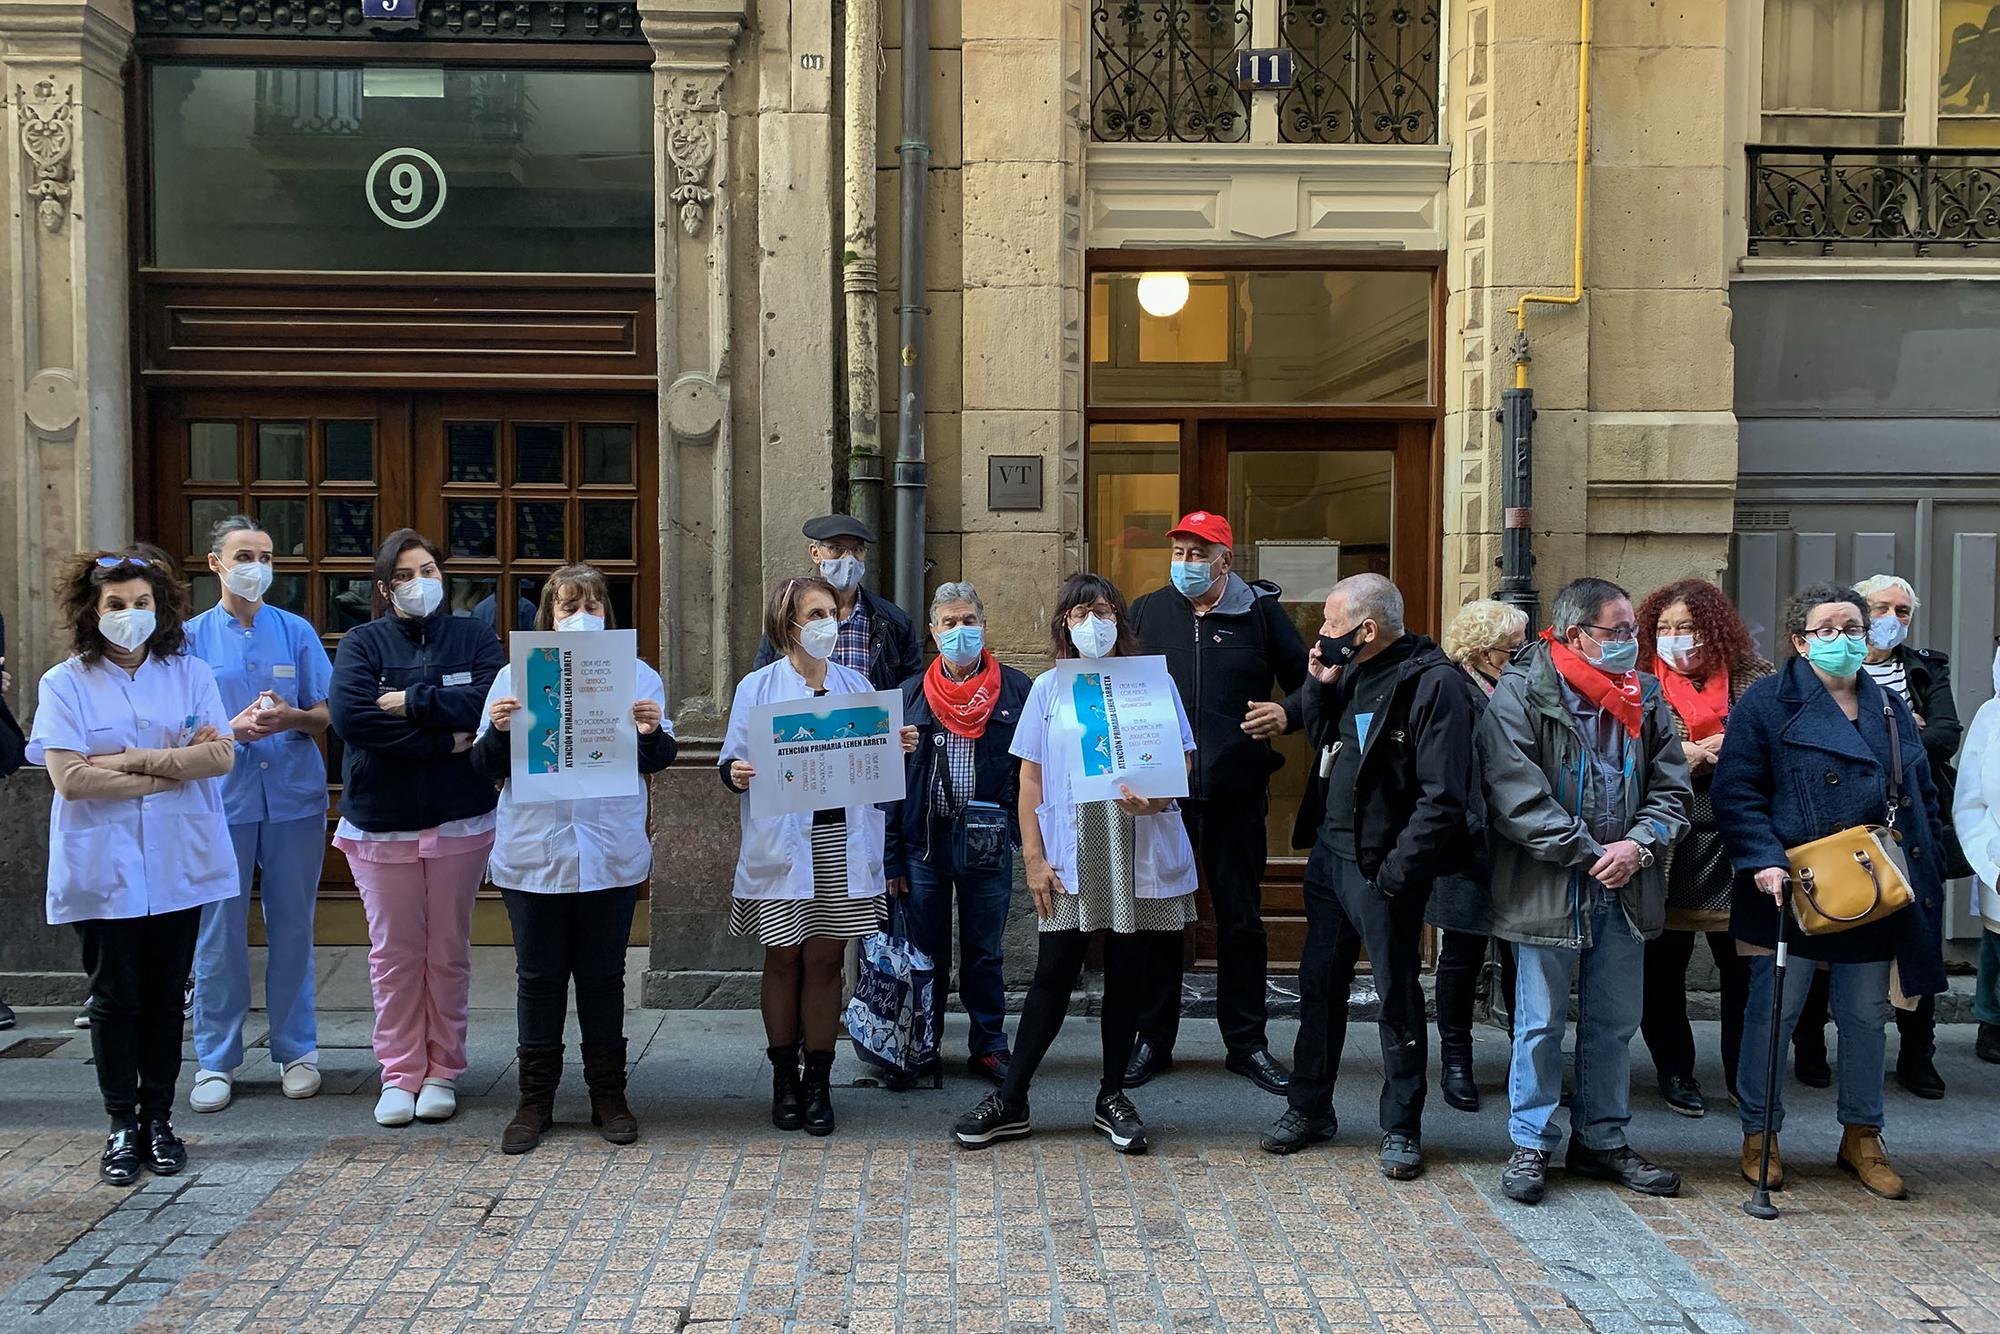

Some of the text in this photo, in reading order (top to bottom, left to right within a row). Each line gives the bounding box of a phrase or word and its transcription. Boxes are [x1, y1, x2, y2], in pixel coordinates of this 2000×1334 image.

[1249, 55, 1280, 83] 11
[389, 163, 423, 214] 9
[996, 465, 1032, 484] VT
[563, 651, 573, 676] ARRETA
[563, 736, 573, 768] ATENCIÓN
[778, 738, 887, 756] ATENCIÓN PRIMARIA-LEHEN ARRETA
